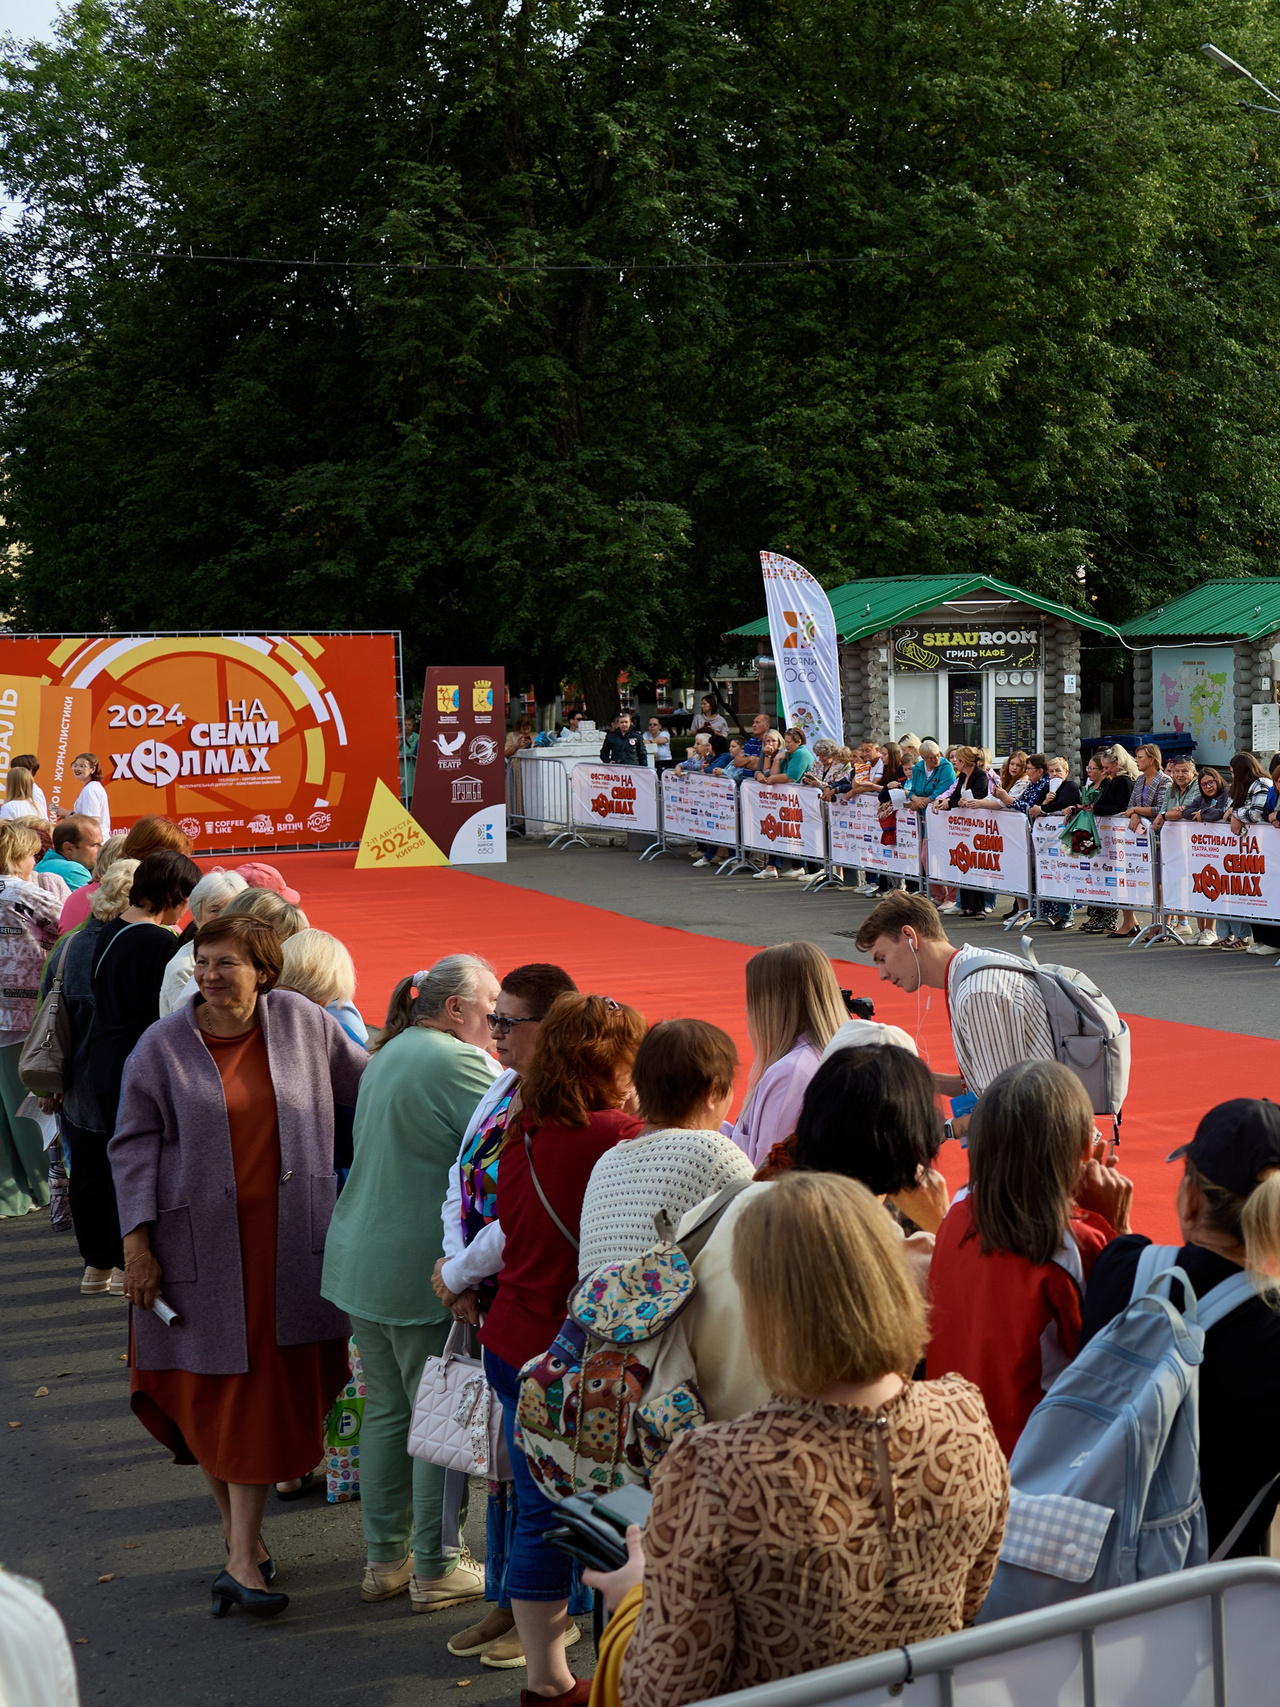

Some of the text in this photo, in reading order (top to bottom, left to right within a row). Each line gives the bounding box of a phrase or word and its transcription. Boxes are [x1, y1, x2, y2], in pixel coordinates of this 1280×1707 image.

[922, 630, 1038, 647] SHAUROOM
[946, 649, 1006, 658] ГРИЛЬ КАФЕ
[107, 703, 186, 729] 2024
[228, 698, 268, 721] НА
[54, 696, 74, 781] ЖУРНАЛИСТИКИ
[189, 720, 279, 747] СЕМИ
[110, 738, 271, 788] ХОЛМАХ
[438, 761, 461, 769] ТЕАТР
[591, 772, 621, 782] ФЕСТИВАЛЬ
[621, 775, 634, 787] НА
[452, 784, 482, 800] ДРУЖБА
[611, 787, 636, 800] СЕМИ
[758, 791, 788, 801] ФЕСТИВАЛЬ
[788, 794, 800, 808] НА
[214, 819, 244, 828] COFFEE
[307, 813, 332, 828] МОРЕ
[779, 806, 804, 823] СЕМИ
[215, 826, 232, 834] LIKE
[364, 819, 413, 848] 2-11 АВГУСТА
[948, 815, 1000, 836] ФЕСТИВАЛЬ НА
[370, 826, 420, 861] 2024
[395, 839, 426, 860] КИРОВ
[973, 833, 1004, 853] СЕМИ
[1191, 834, 1260, 854] ФЕСТИВАЛЬ НА
[949, 841, 1001, 874] ХОЛМАХ
[1223, 853, 1265, 874] СЕМИ
[1192, 863, 1263, 902] ХОЛМАХ
